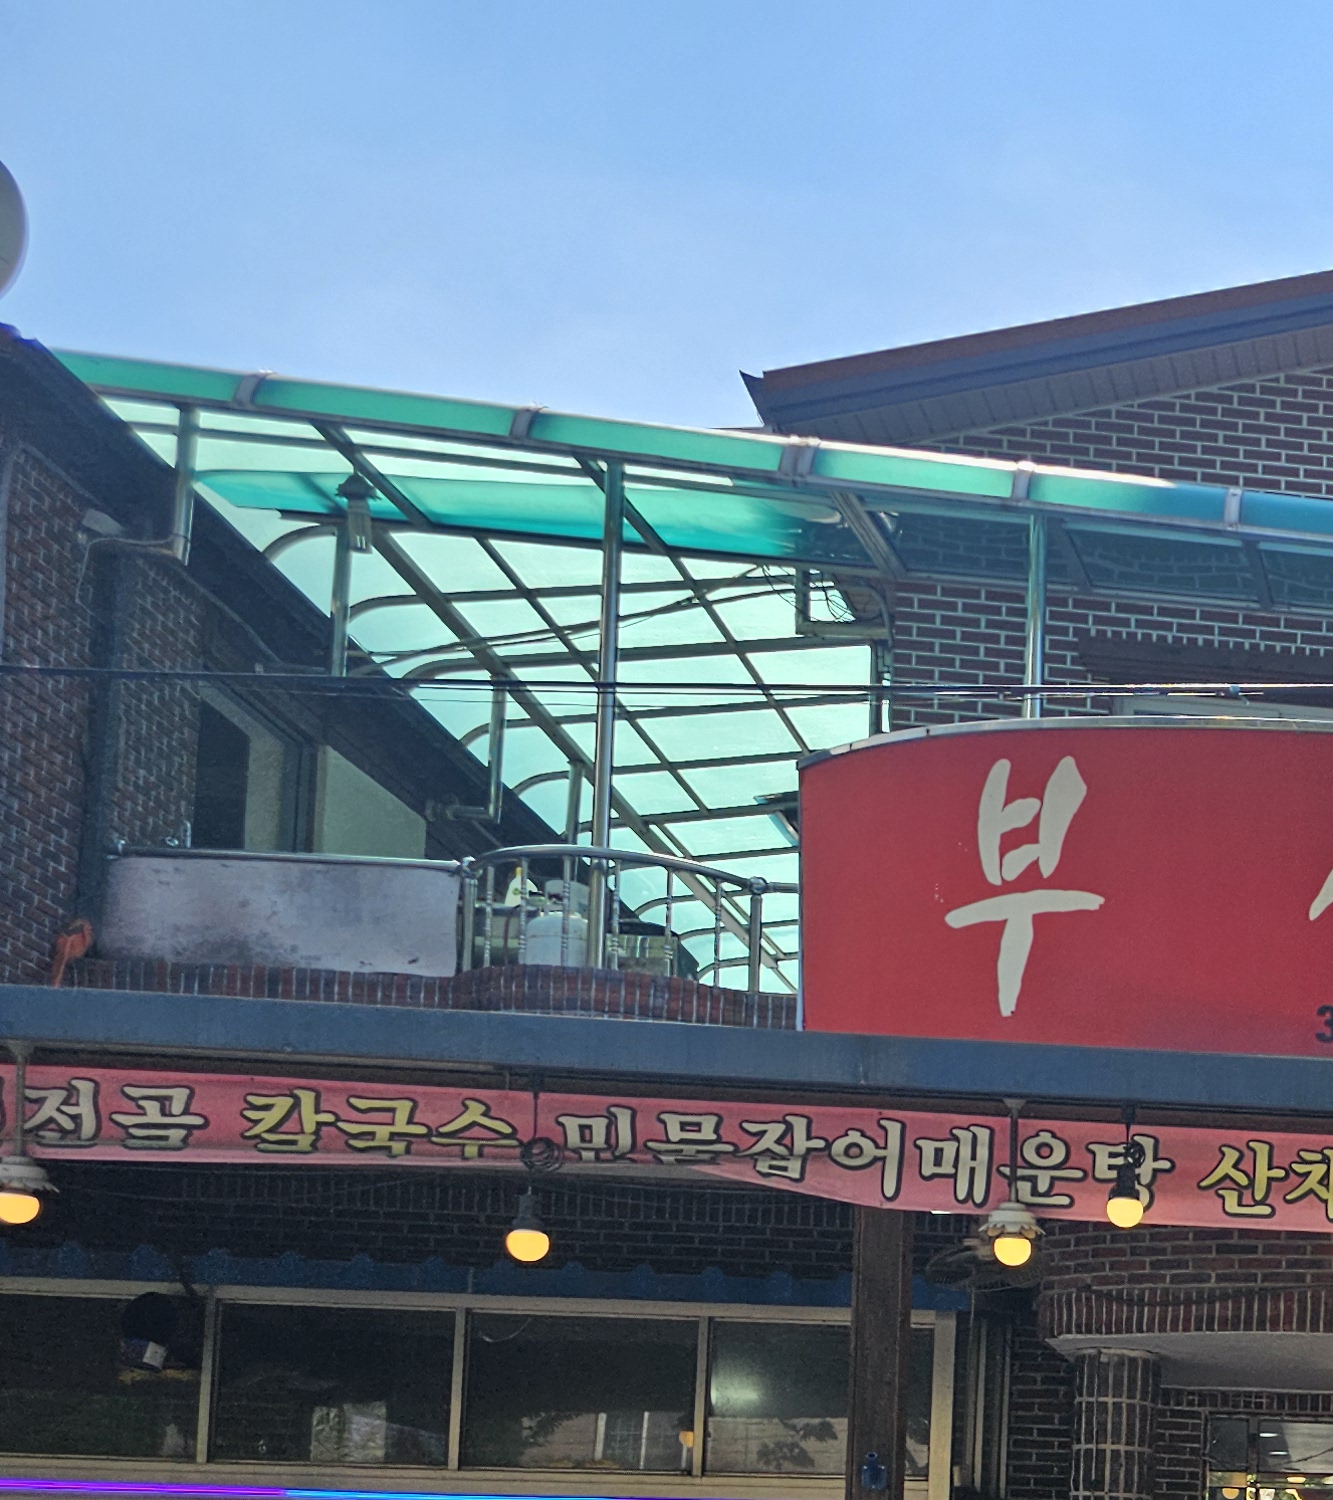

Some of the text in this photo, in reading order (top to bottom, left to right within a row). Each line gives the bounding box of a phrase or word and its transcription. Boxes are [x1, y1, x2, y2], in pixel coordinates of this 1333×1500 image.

[25, 1078, 206, 1151] 전골
[243, 1089, 521, 1160] 칼국수
[560, 1104, 1174, 1208] 민물잡어매운탕
